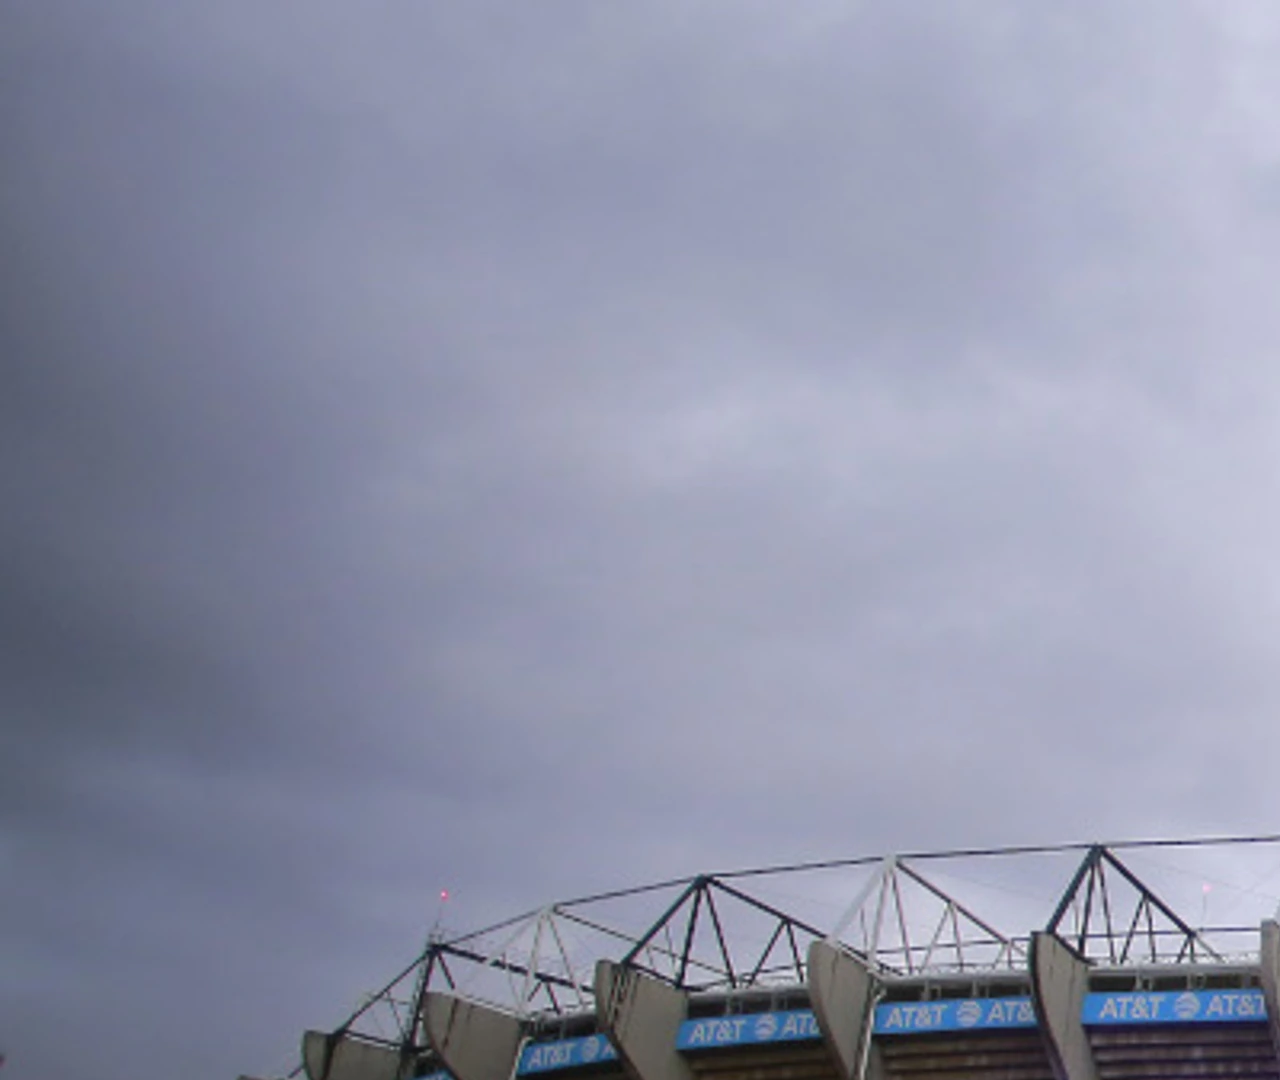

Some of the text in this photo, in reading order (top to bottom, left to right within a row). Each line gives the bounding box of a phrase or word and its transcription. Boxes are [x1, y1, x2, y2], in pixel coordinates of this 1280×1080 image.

[885, 1004, 948, 1028] AT&T
[1100, 996, 1166, 1020] AT&T
[689, 1017, 747, 1044] AT&T
[527, 1042, 576, 1071] AT&T
